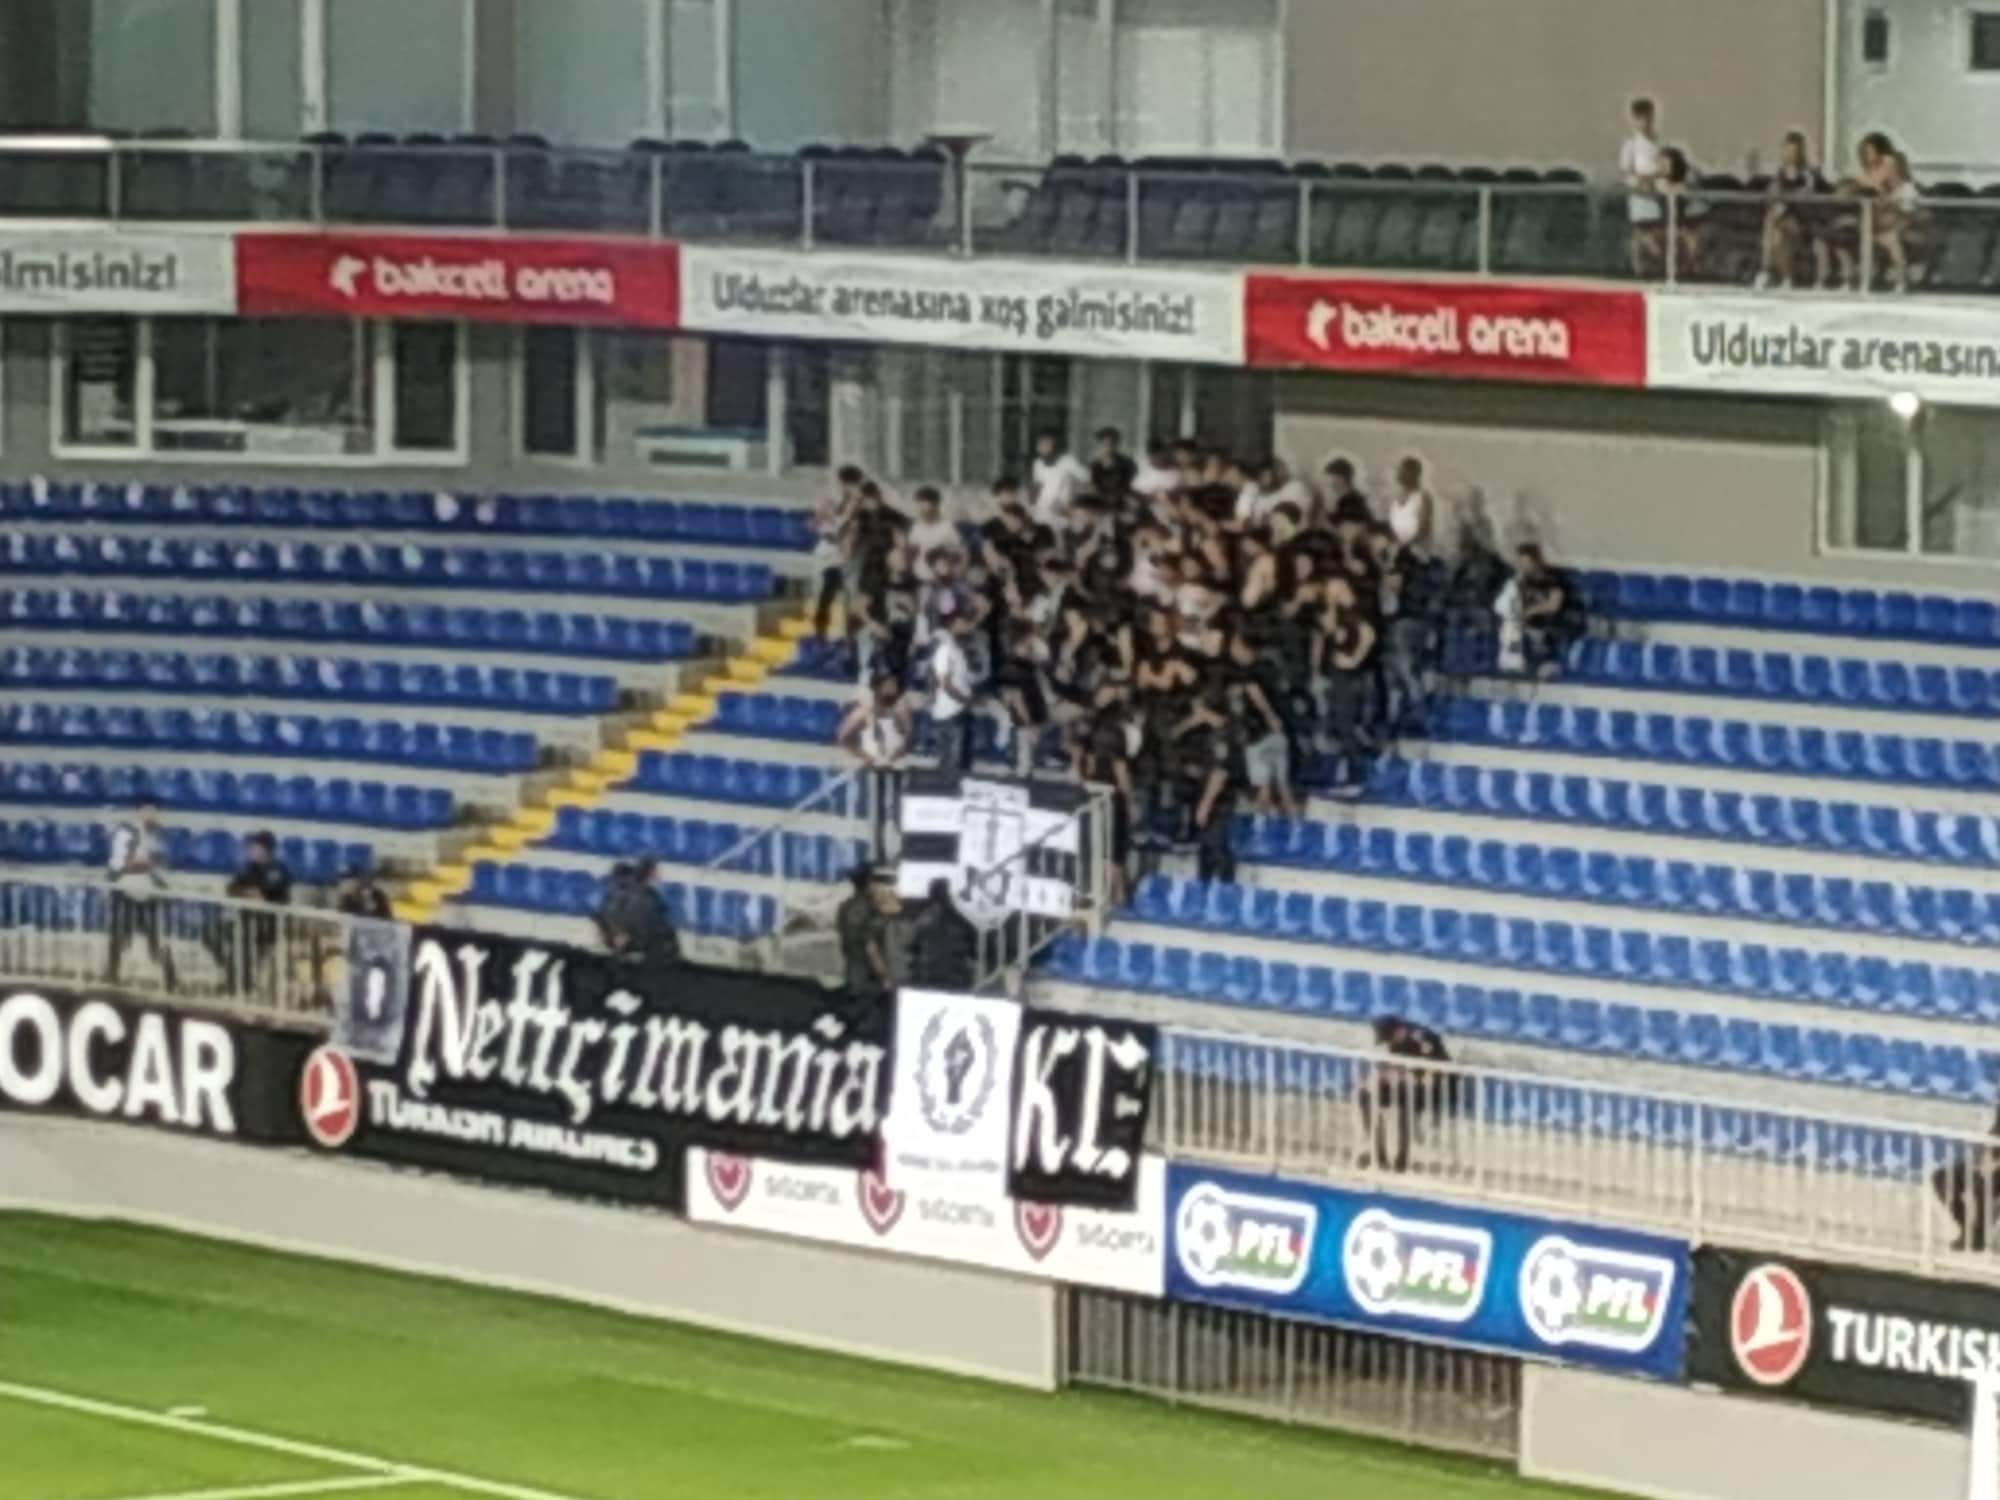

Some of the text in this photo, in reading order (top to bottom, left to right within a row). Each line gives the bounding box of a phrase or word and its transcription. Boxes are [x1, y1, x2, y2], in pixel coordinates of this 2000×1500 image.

[515, 267, 614, 304] arena
[1341, 303, 1570, 359] bakcell arena
[1690, 321, 2000, 378] Ulduzlar arenasın
[0, 992, 236, 1133] OCAR
[1236, 1219, 1297, 1266] PFL
[1406, 1246, 1469, 1295] PFL
[1586, 1273, 1648, 1322] PFL
